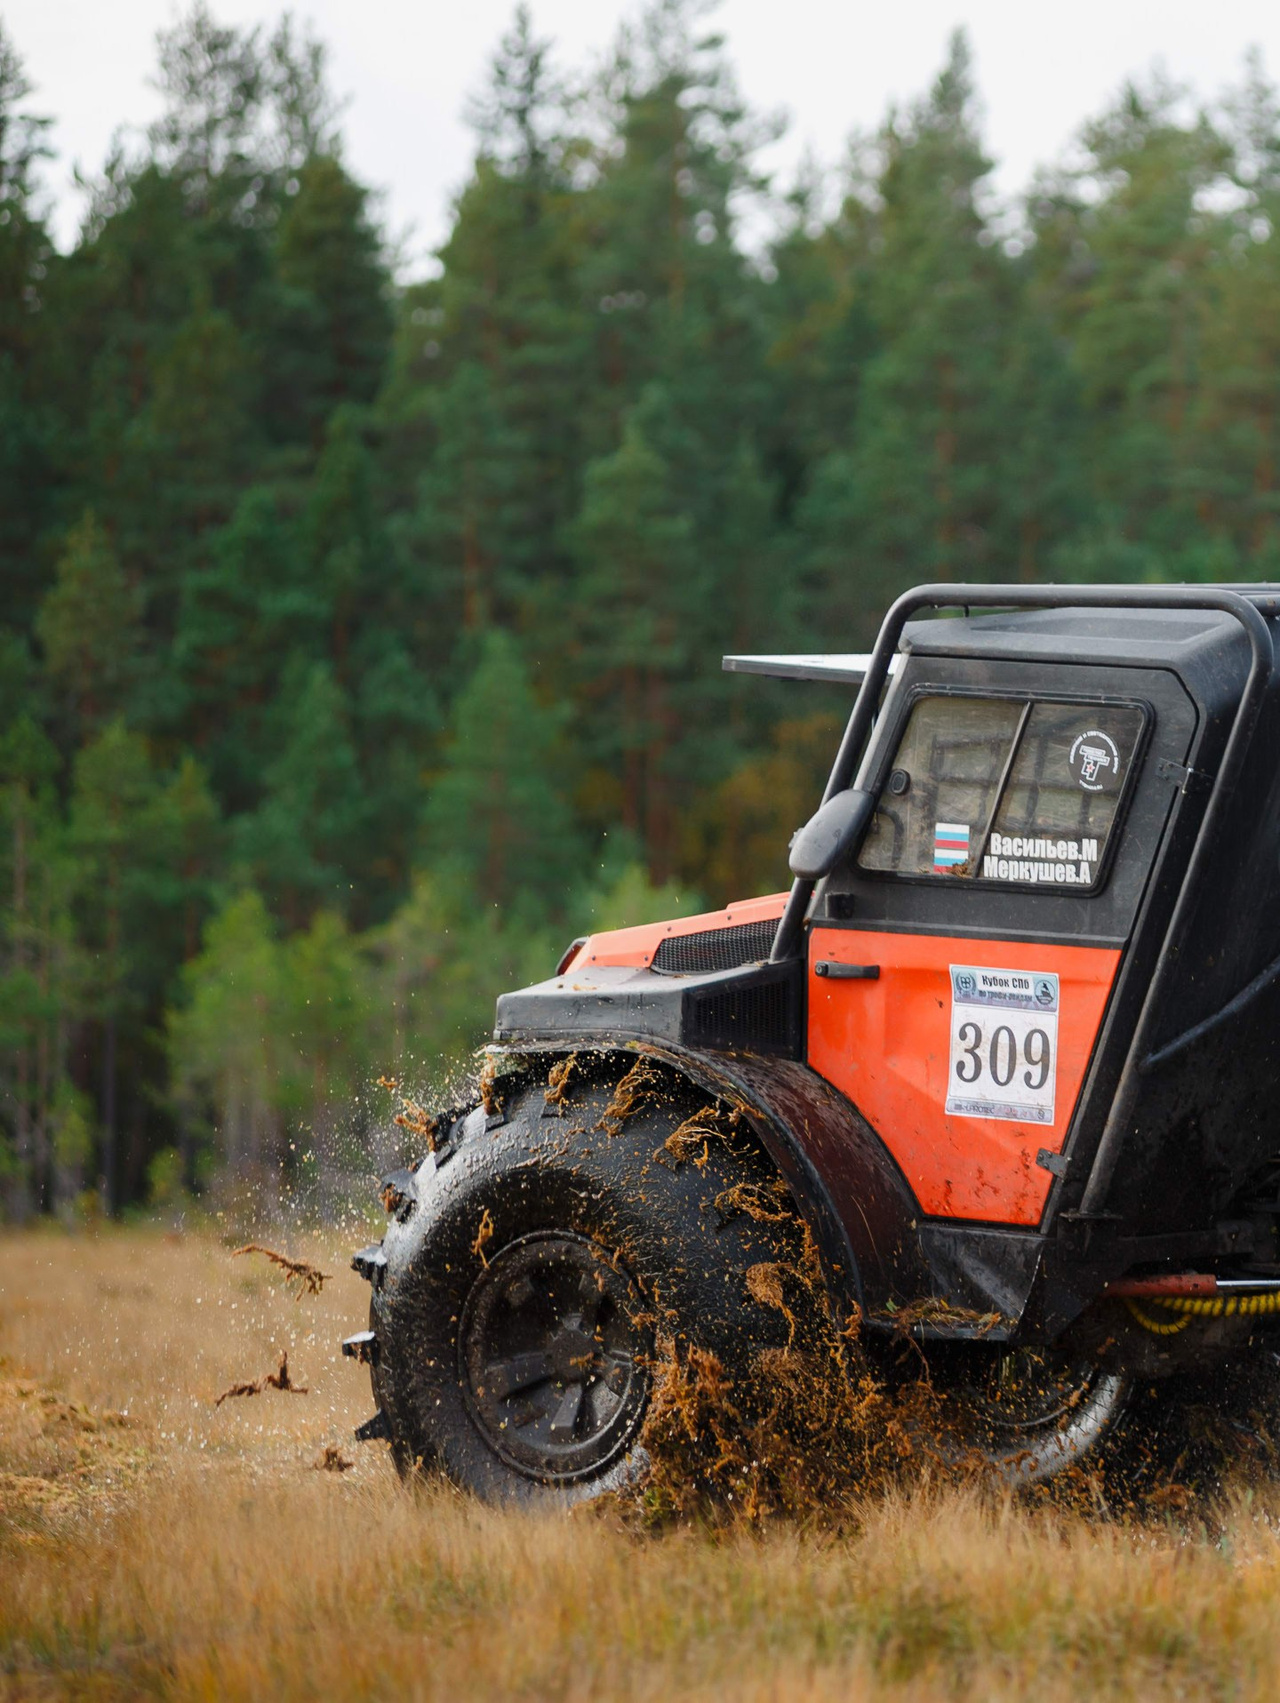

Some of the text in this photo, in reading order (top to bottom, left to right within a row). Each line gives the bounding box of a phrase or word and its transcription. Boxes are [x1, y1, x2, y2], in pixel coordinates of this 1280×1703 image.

[990, 832, 1097, 862] Васильев.М
[983, 855, 1091, 884] Меркушев.А
[981, 975, 1030, 990] Кубок СПб
[955, 1021, 1051, 1090] 309
